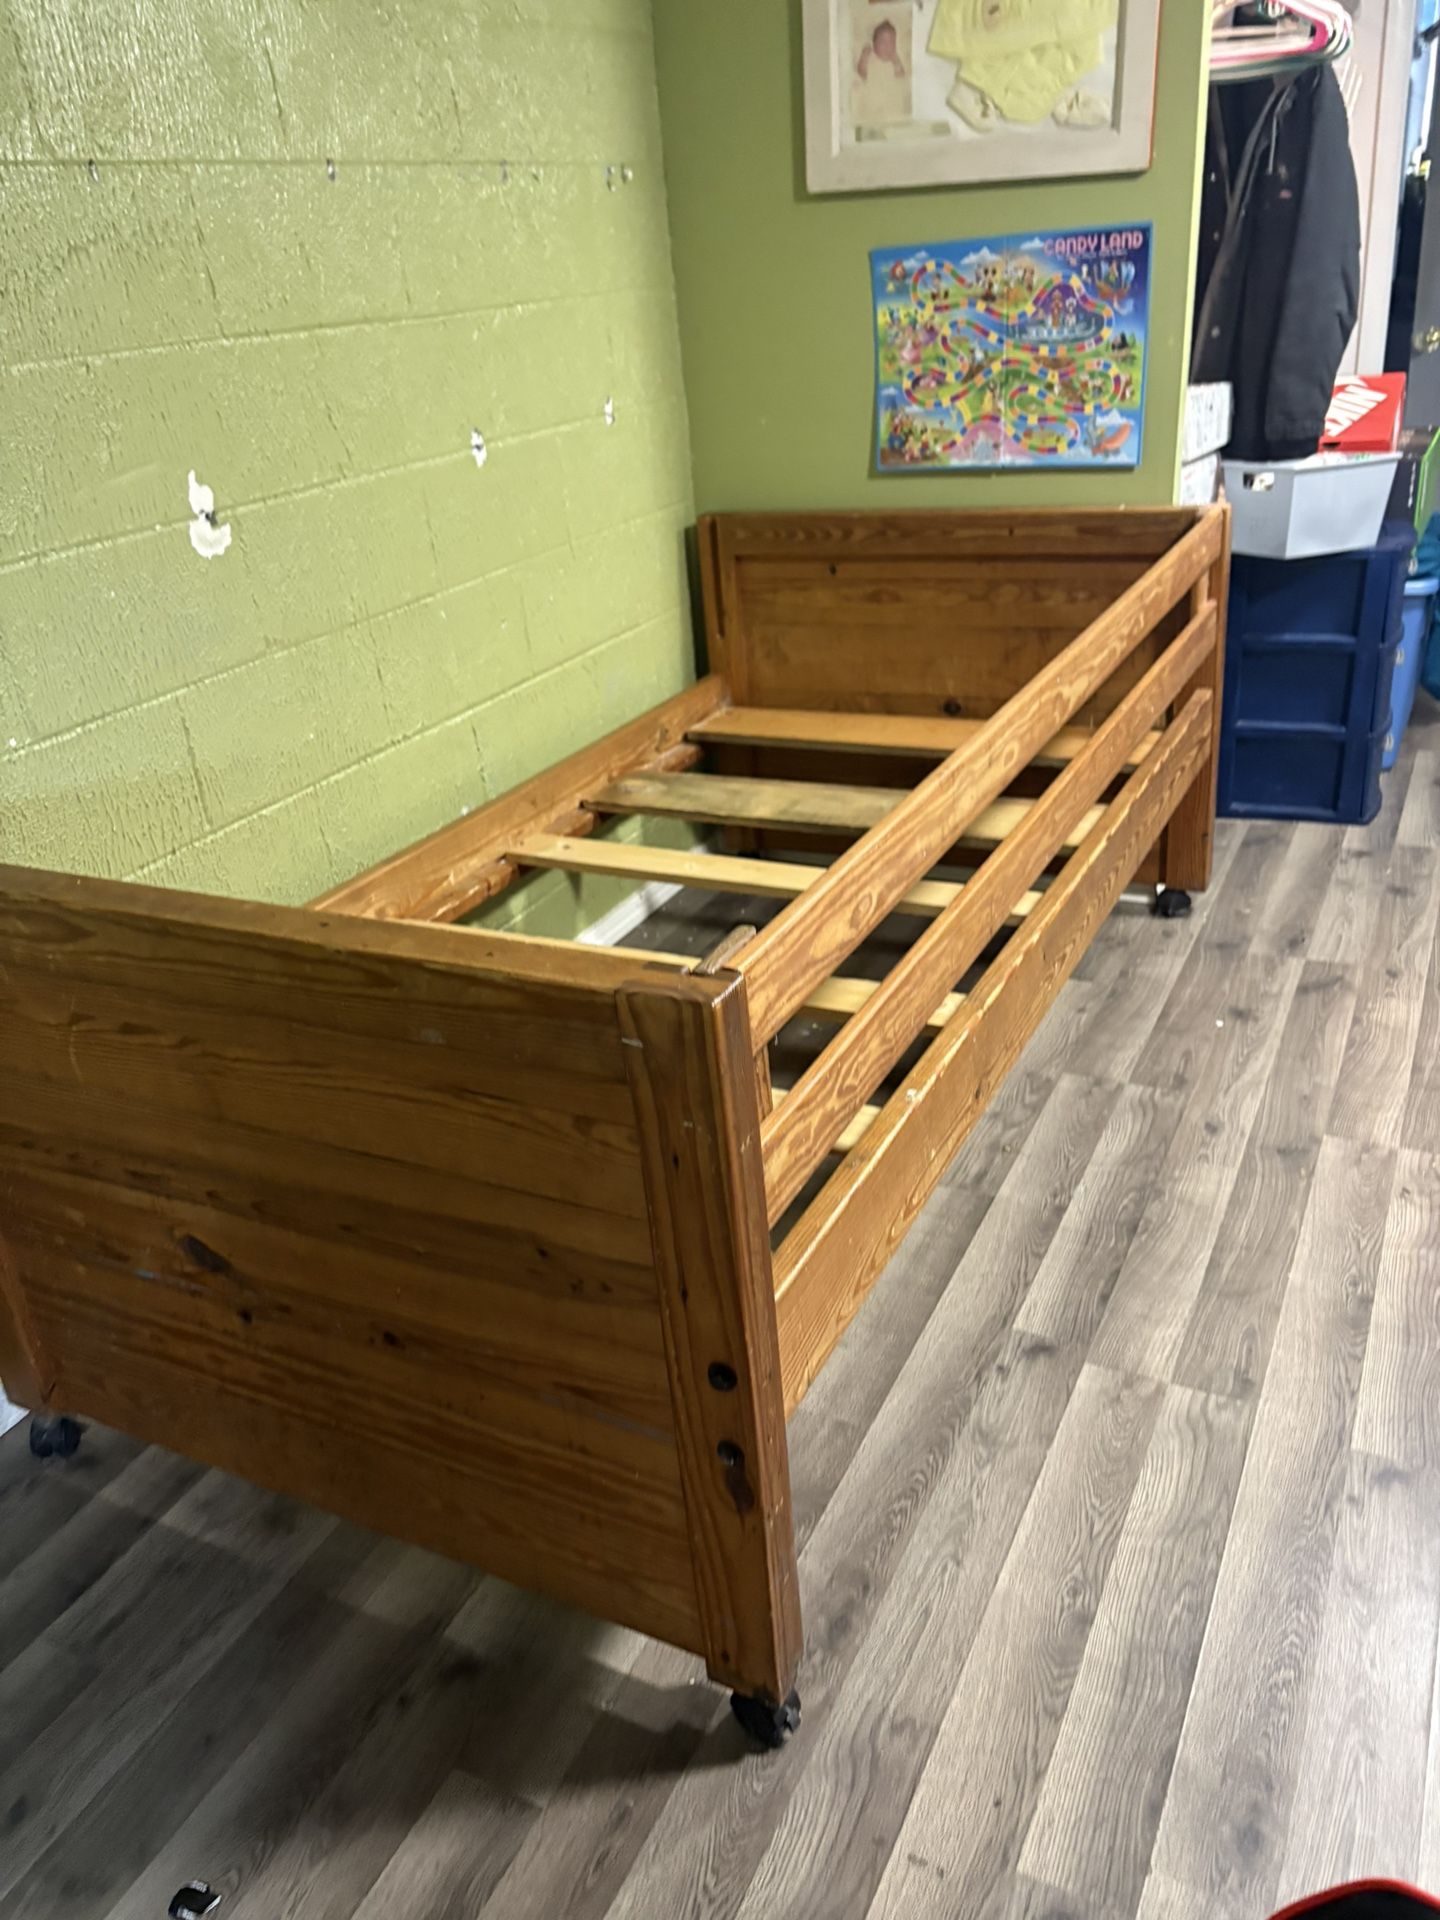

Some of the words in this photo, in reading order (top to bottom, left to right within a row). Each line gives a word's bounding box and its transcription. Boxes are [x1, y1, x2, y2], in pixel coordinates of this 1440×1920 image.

[1043, 233, 1098, 257] CANDY
[1101, 231, 1143, 253] LAND
[1324, 384, 1388, 437] NIK
